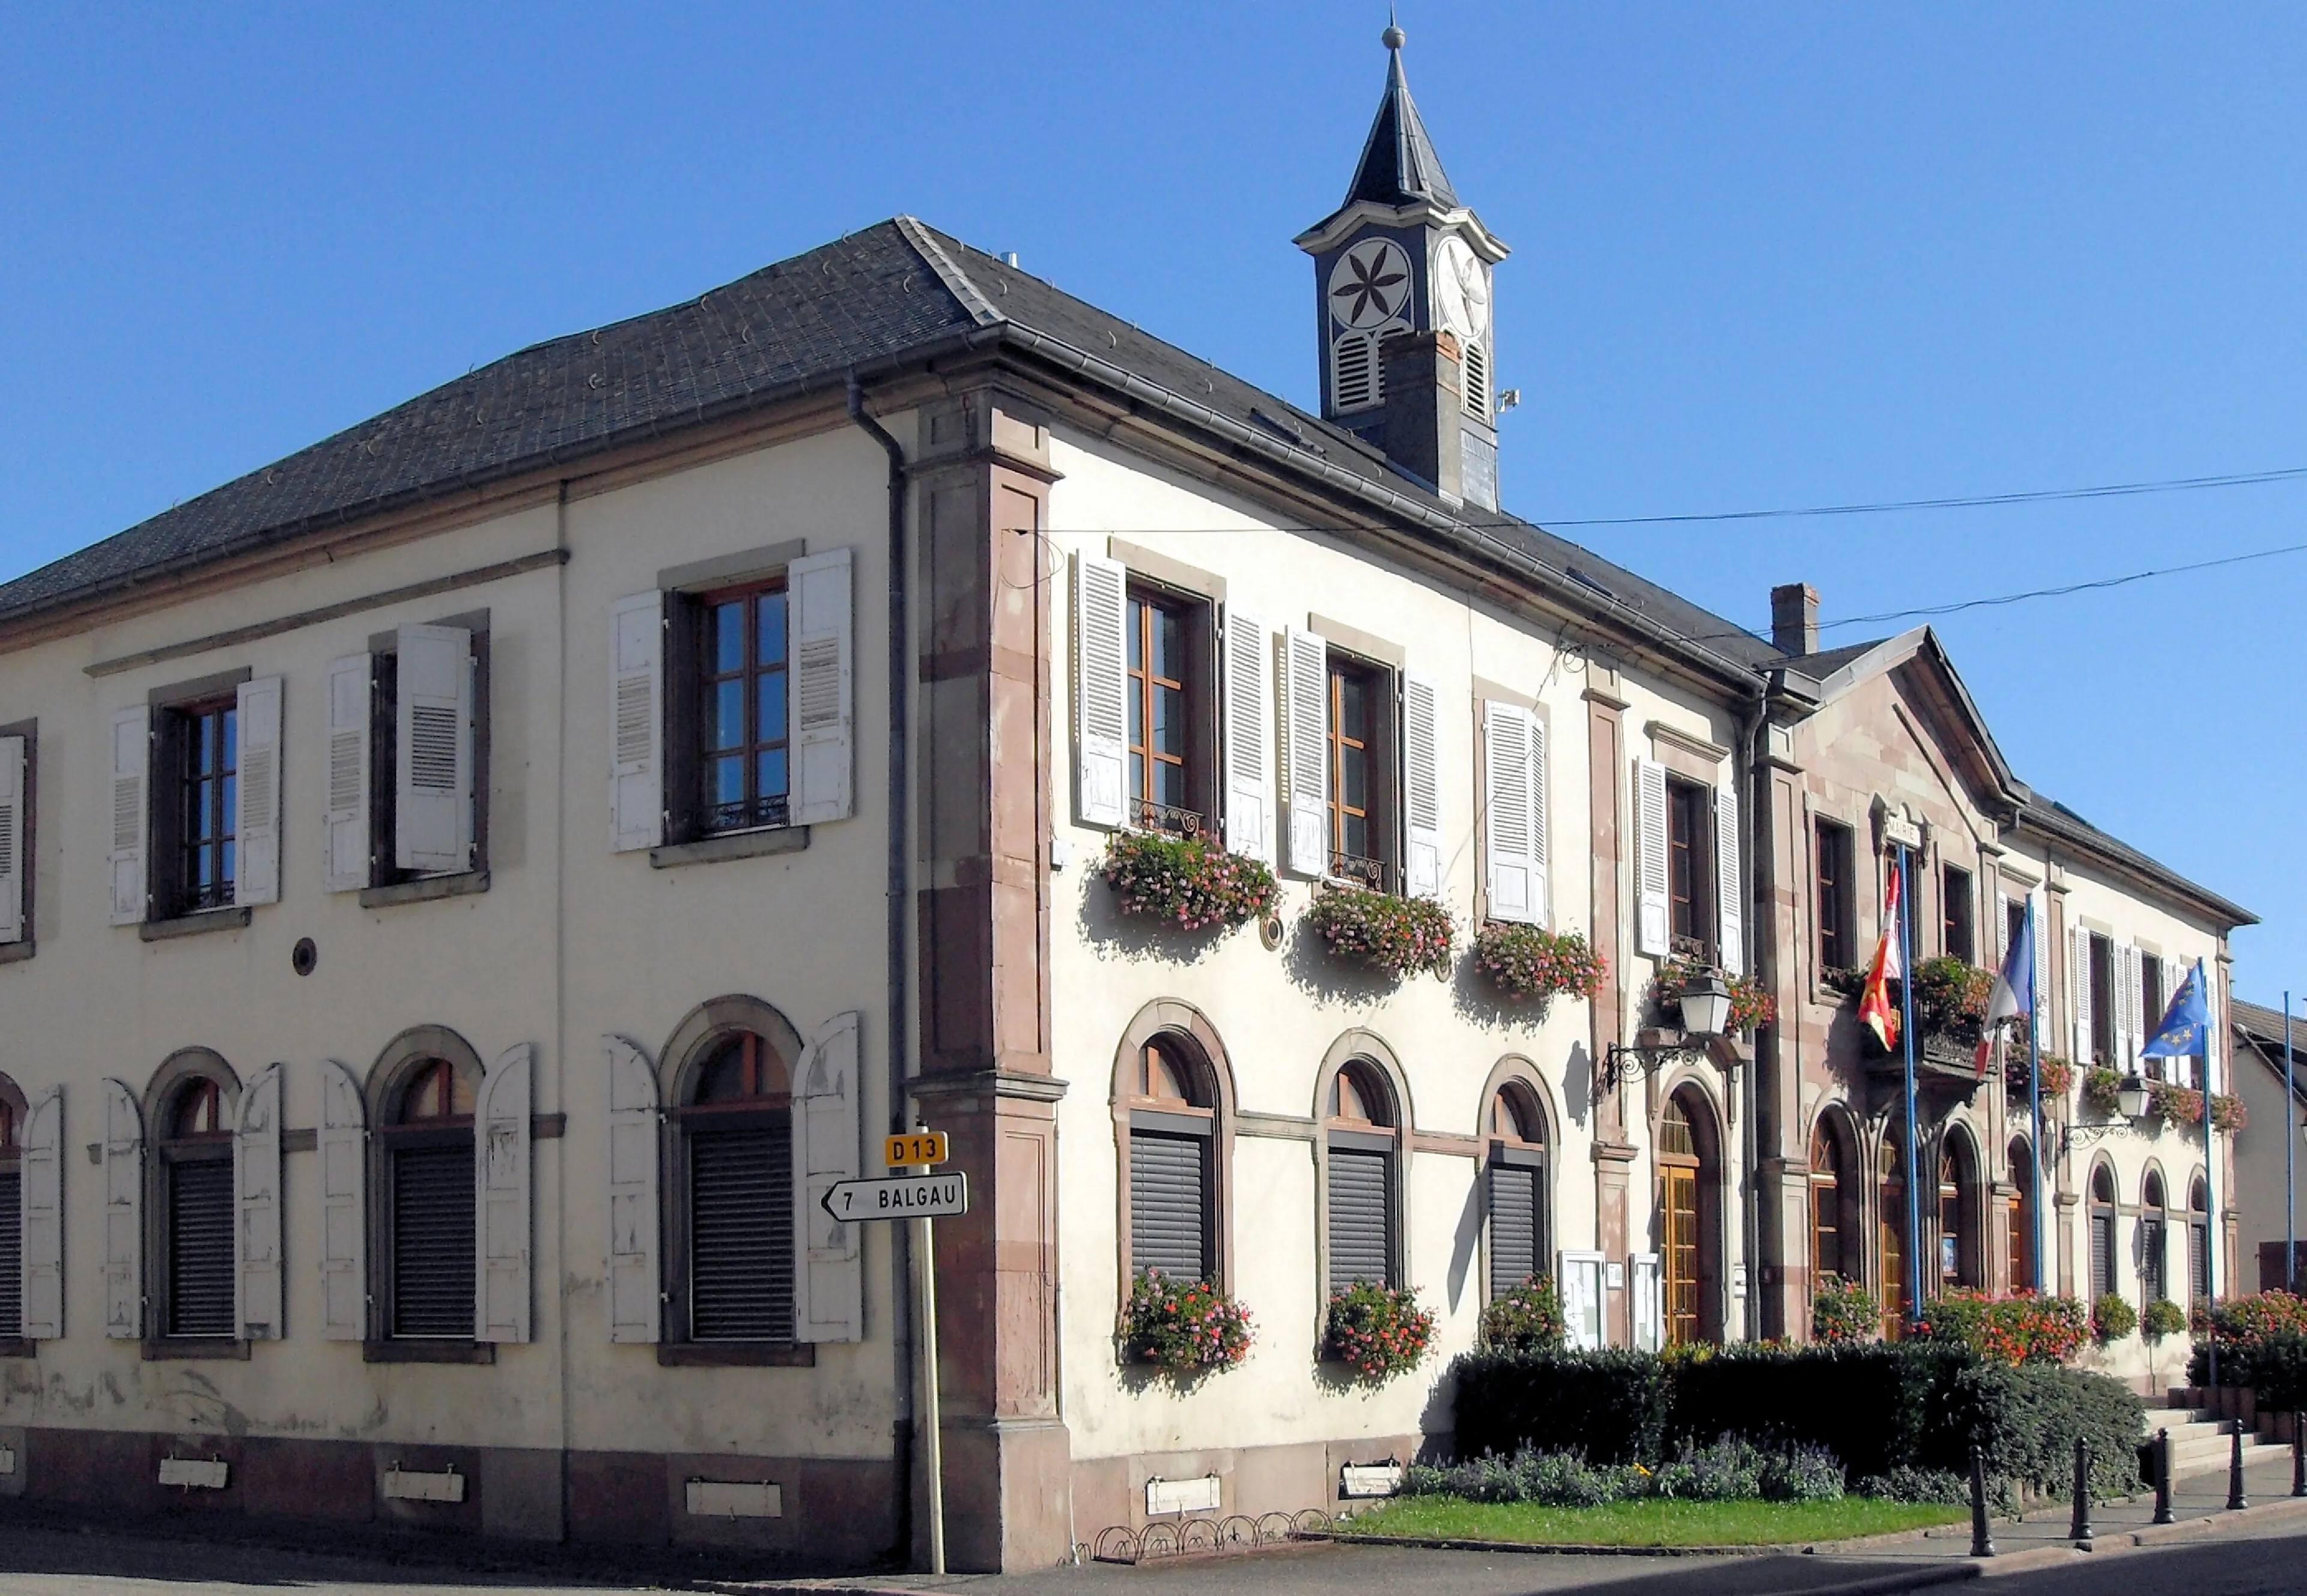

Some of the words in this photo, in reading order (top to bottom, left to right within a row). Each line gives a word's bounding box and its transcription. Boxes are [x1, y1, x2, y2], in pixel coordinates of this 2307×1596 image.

[1888, 819, 1915, 840] MAIRIE
[893, 1142, 904, 1160] D
[912, 1139, 936, 1159] 13
[843, 1192, 853, 1211] 7
[879, 1185, 955, 1208] BALGAU
